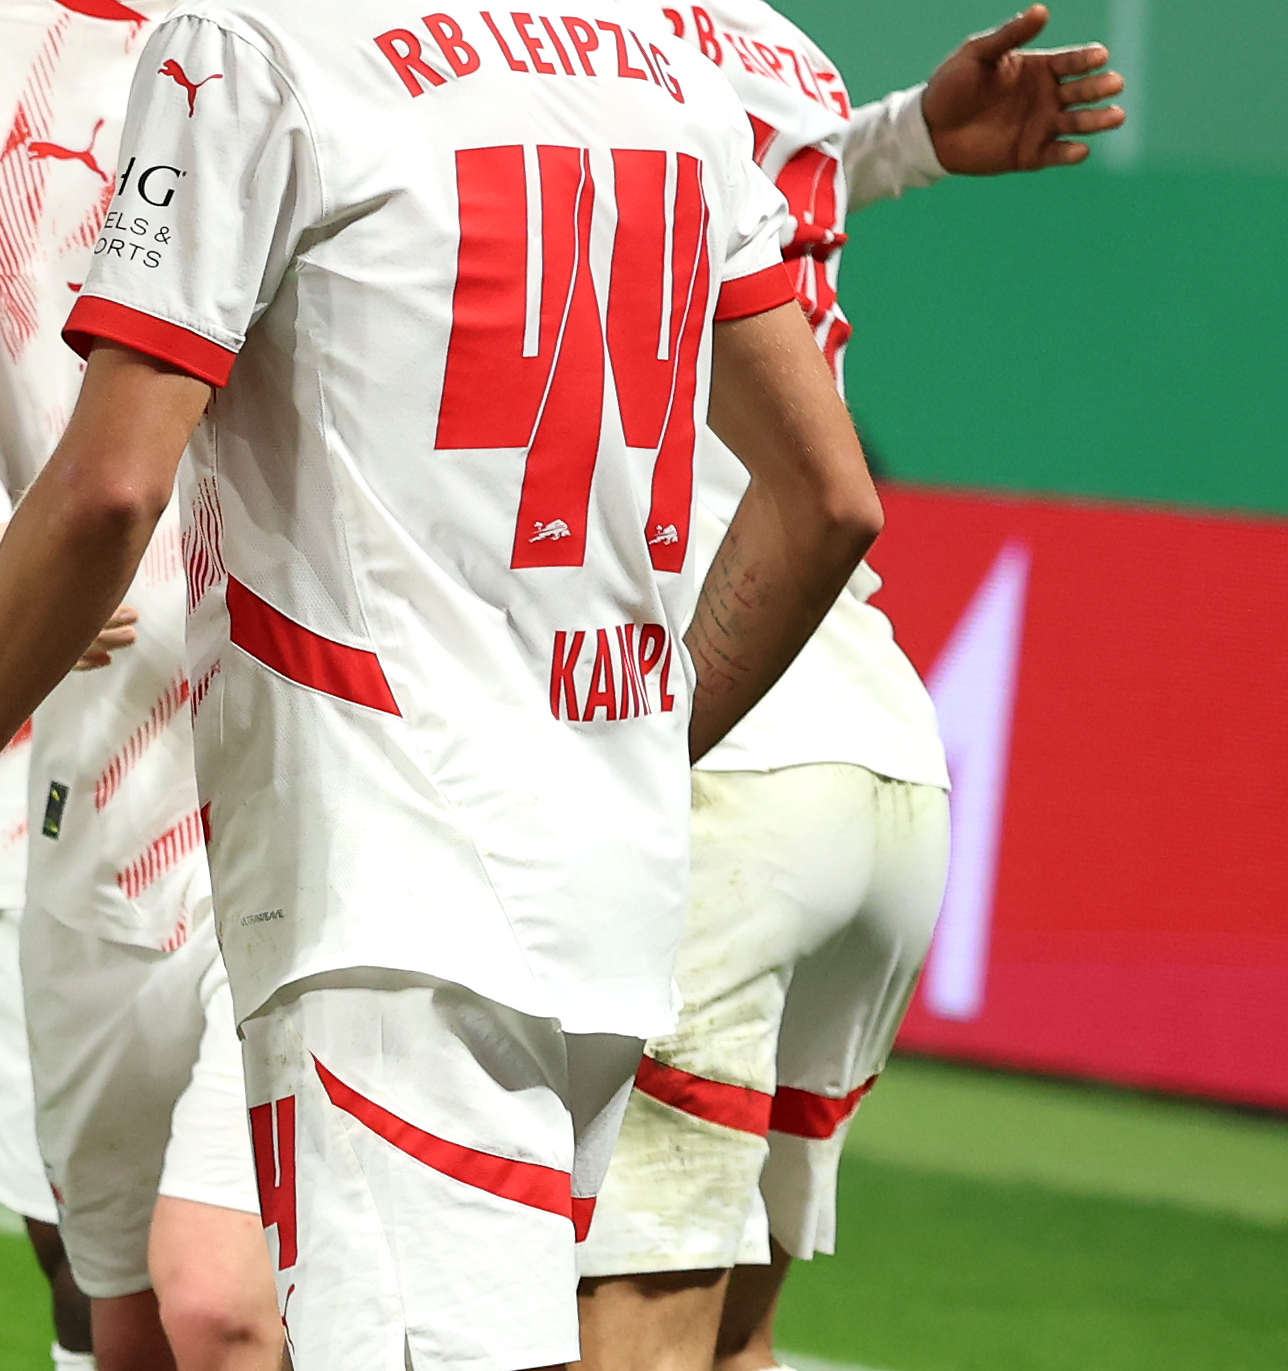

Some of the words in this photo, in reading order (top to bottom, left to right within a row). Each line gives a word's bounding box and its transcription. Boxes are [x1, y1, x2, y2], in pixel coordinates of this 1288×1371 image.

[373, 13, 481, 98] RB
[480, 11, 685, 104] LEIPZIG
[154, 226, 171, 244] &
[434, 144, 709, 572] 44
